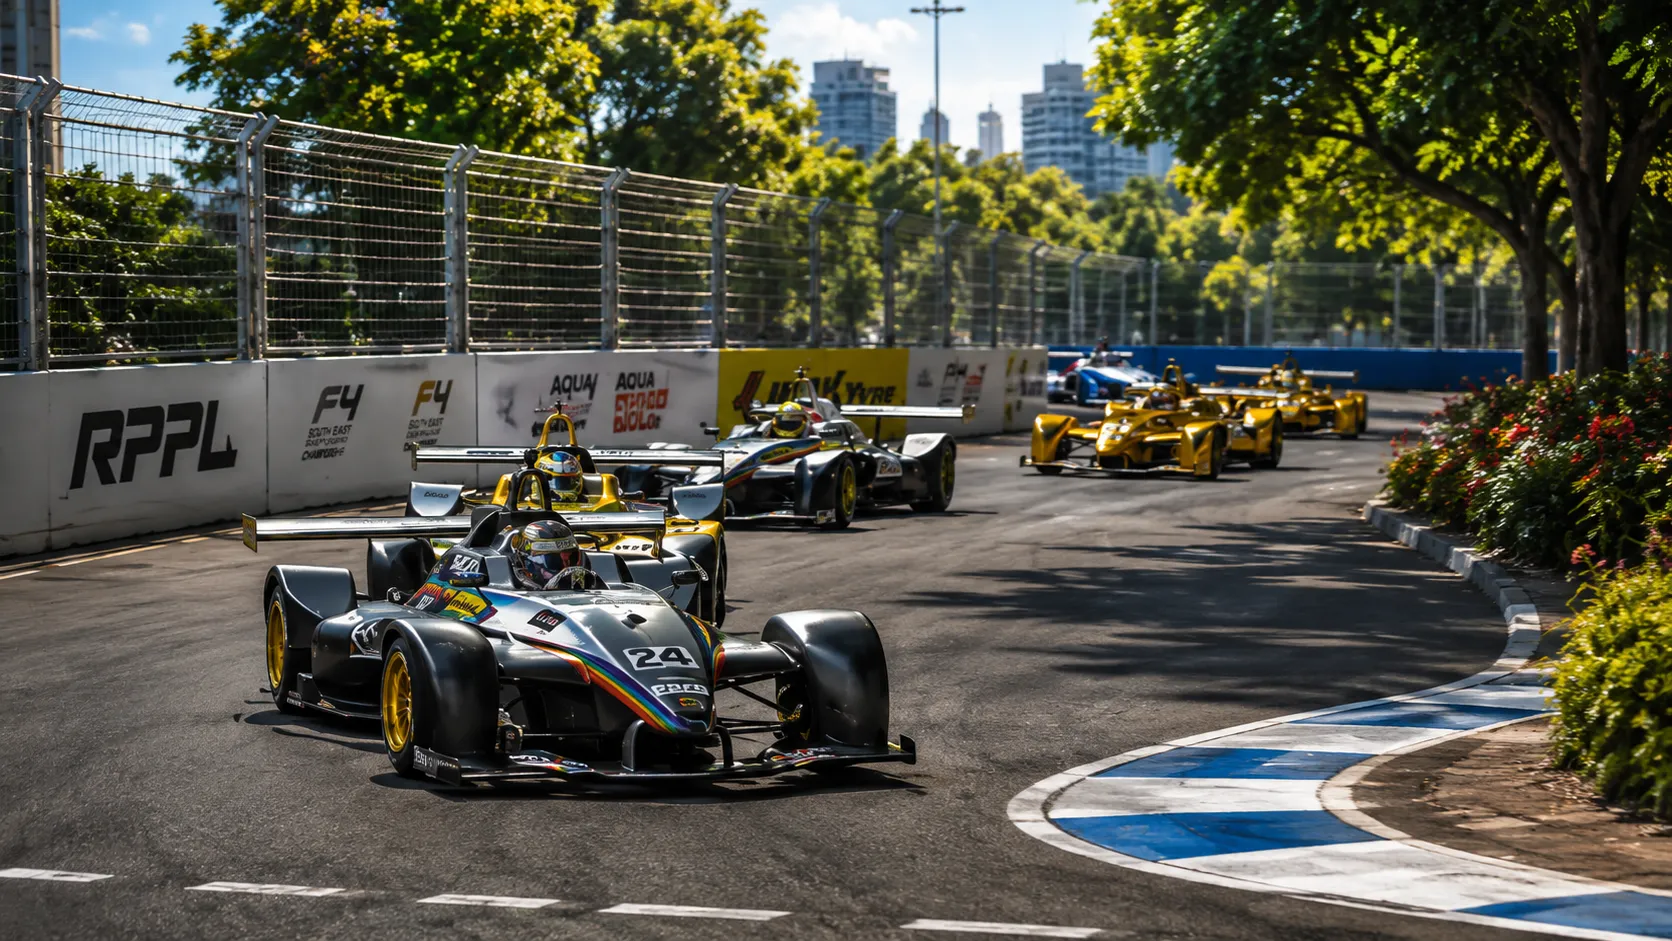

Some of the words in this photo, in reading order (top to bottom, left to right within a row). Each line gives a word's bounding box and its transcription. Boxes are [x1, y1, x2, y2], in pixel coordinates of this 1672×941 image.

[615, 371, 655, 391] AQUA
[311, 384, 364, 424] F4
[411, 380, 454, 416] F4
[332, 424, 352, 436] EAST
[70, 400, 238, 490] RPPL
[628, 647, 693, 668] 24
